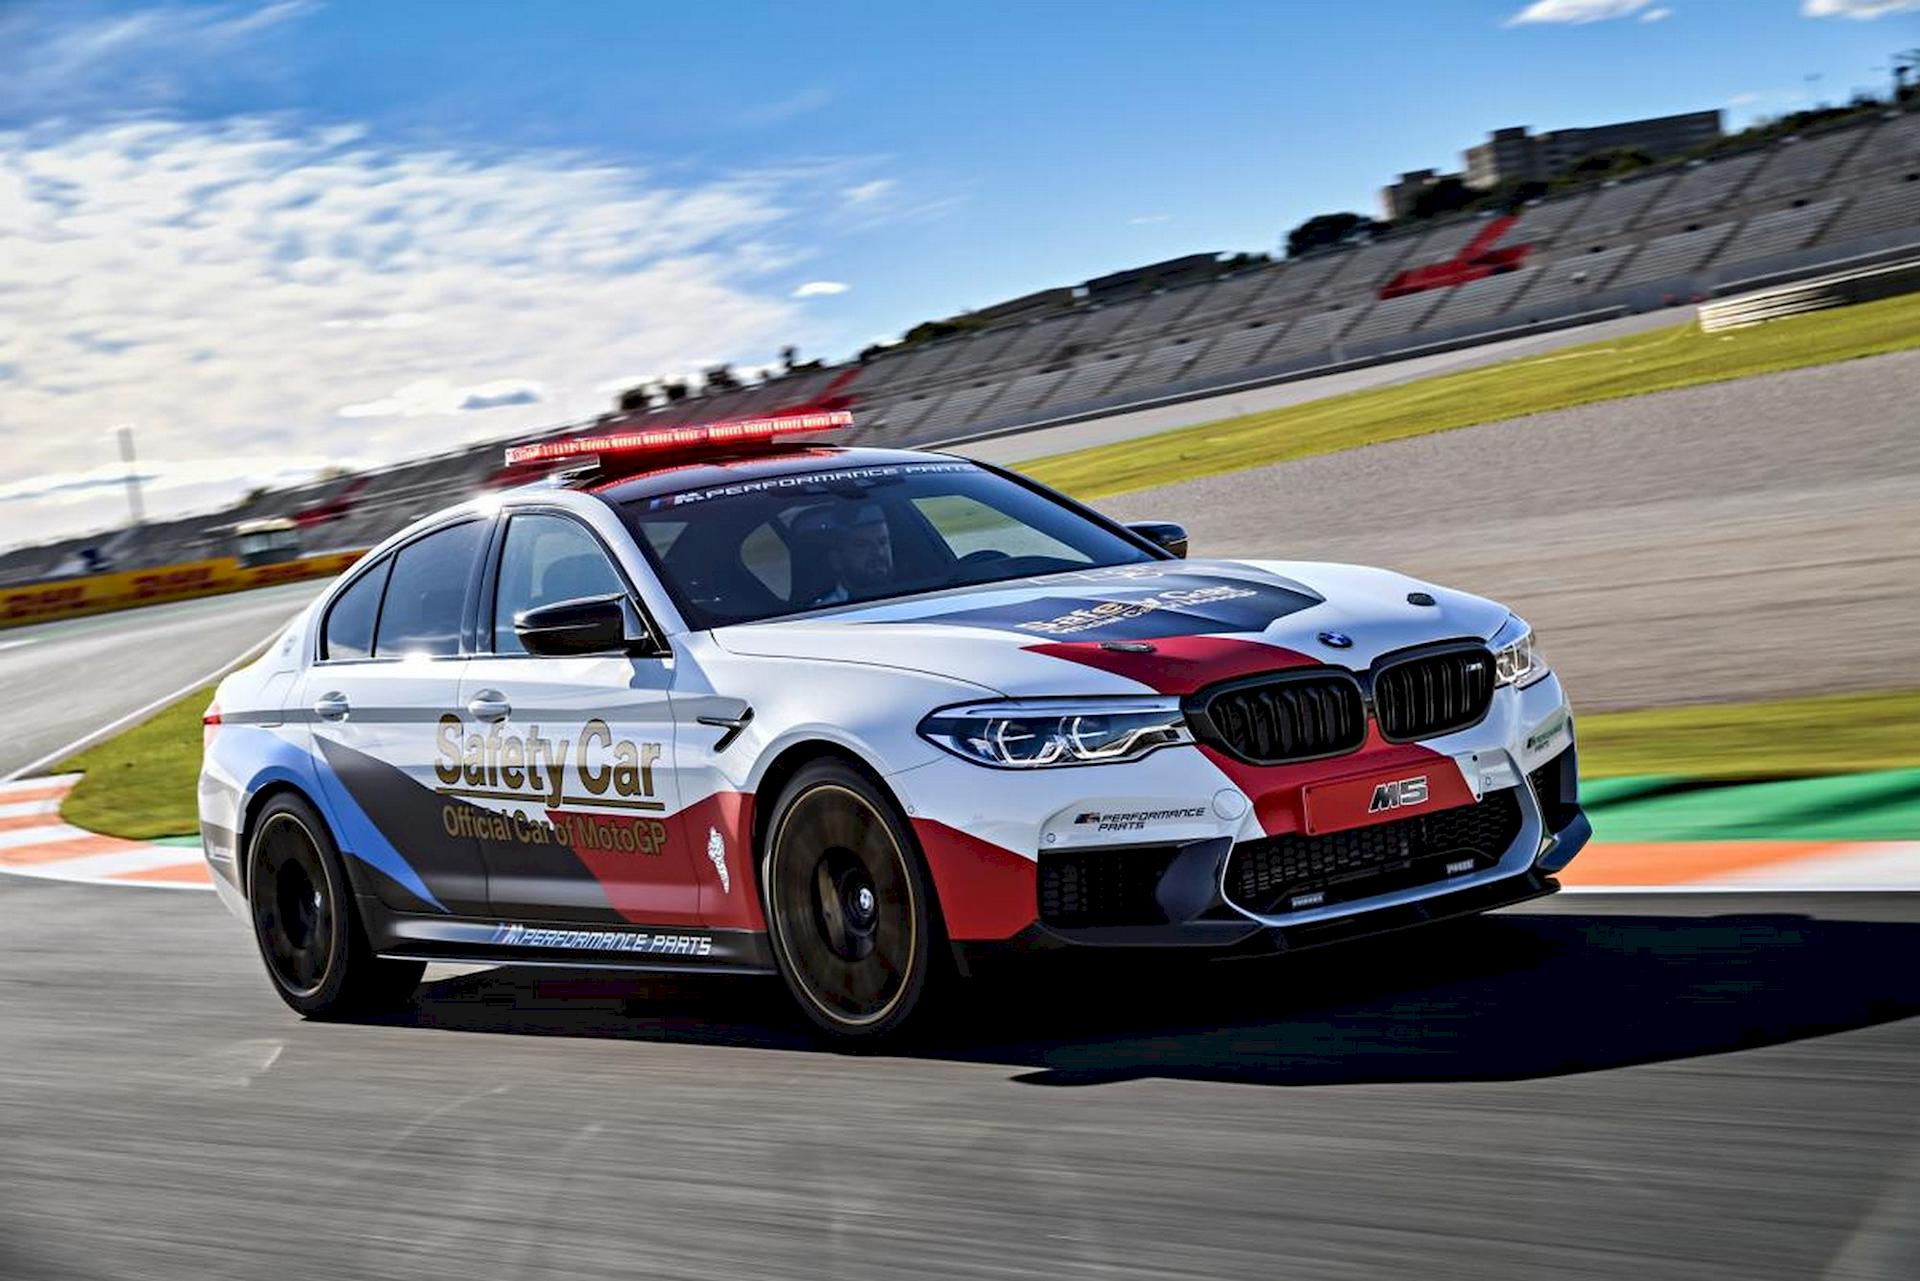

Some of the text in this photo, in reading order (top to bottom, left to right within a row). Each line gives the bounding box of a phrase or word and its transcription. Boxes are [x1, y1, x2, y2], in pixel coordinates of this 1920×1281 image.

[705, 467, 899, 499] PERFORMANCE
[434, 713, 662, 808] Safety Car
[1368, 775, 1429, 813] M5
[442, 805, 667, 854] Official Car of MotoGP
[1098, 822, 1145, 832] PARTS
[1101, 807, 1206, 823] PERFORMANCE
[521, 928, 648, 951] PERFORMANCE
[649, 935, 713, 955] PARTS
